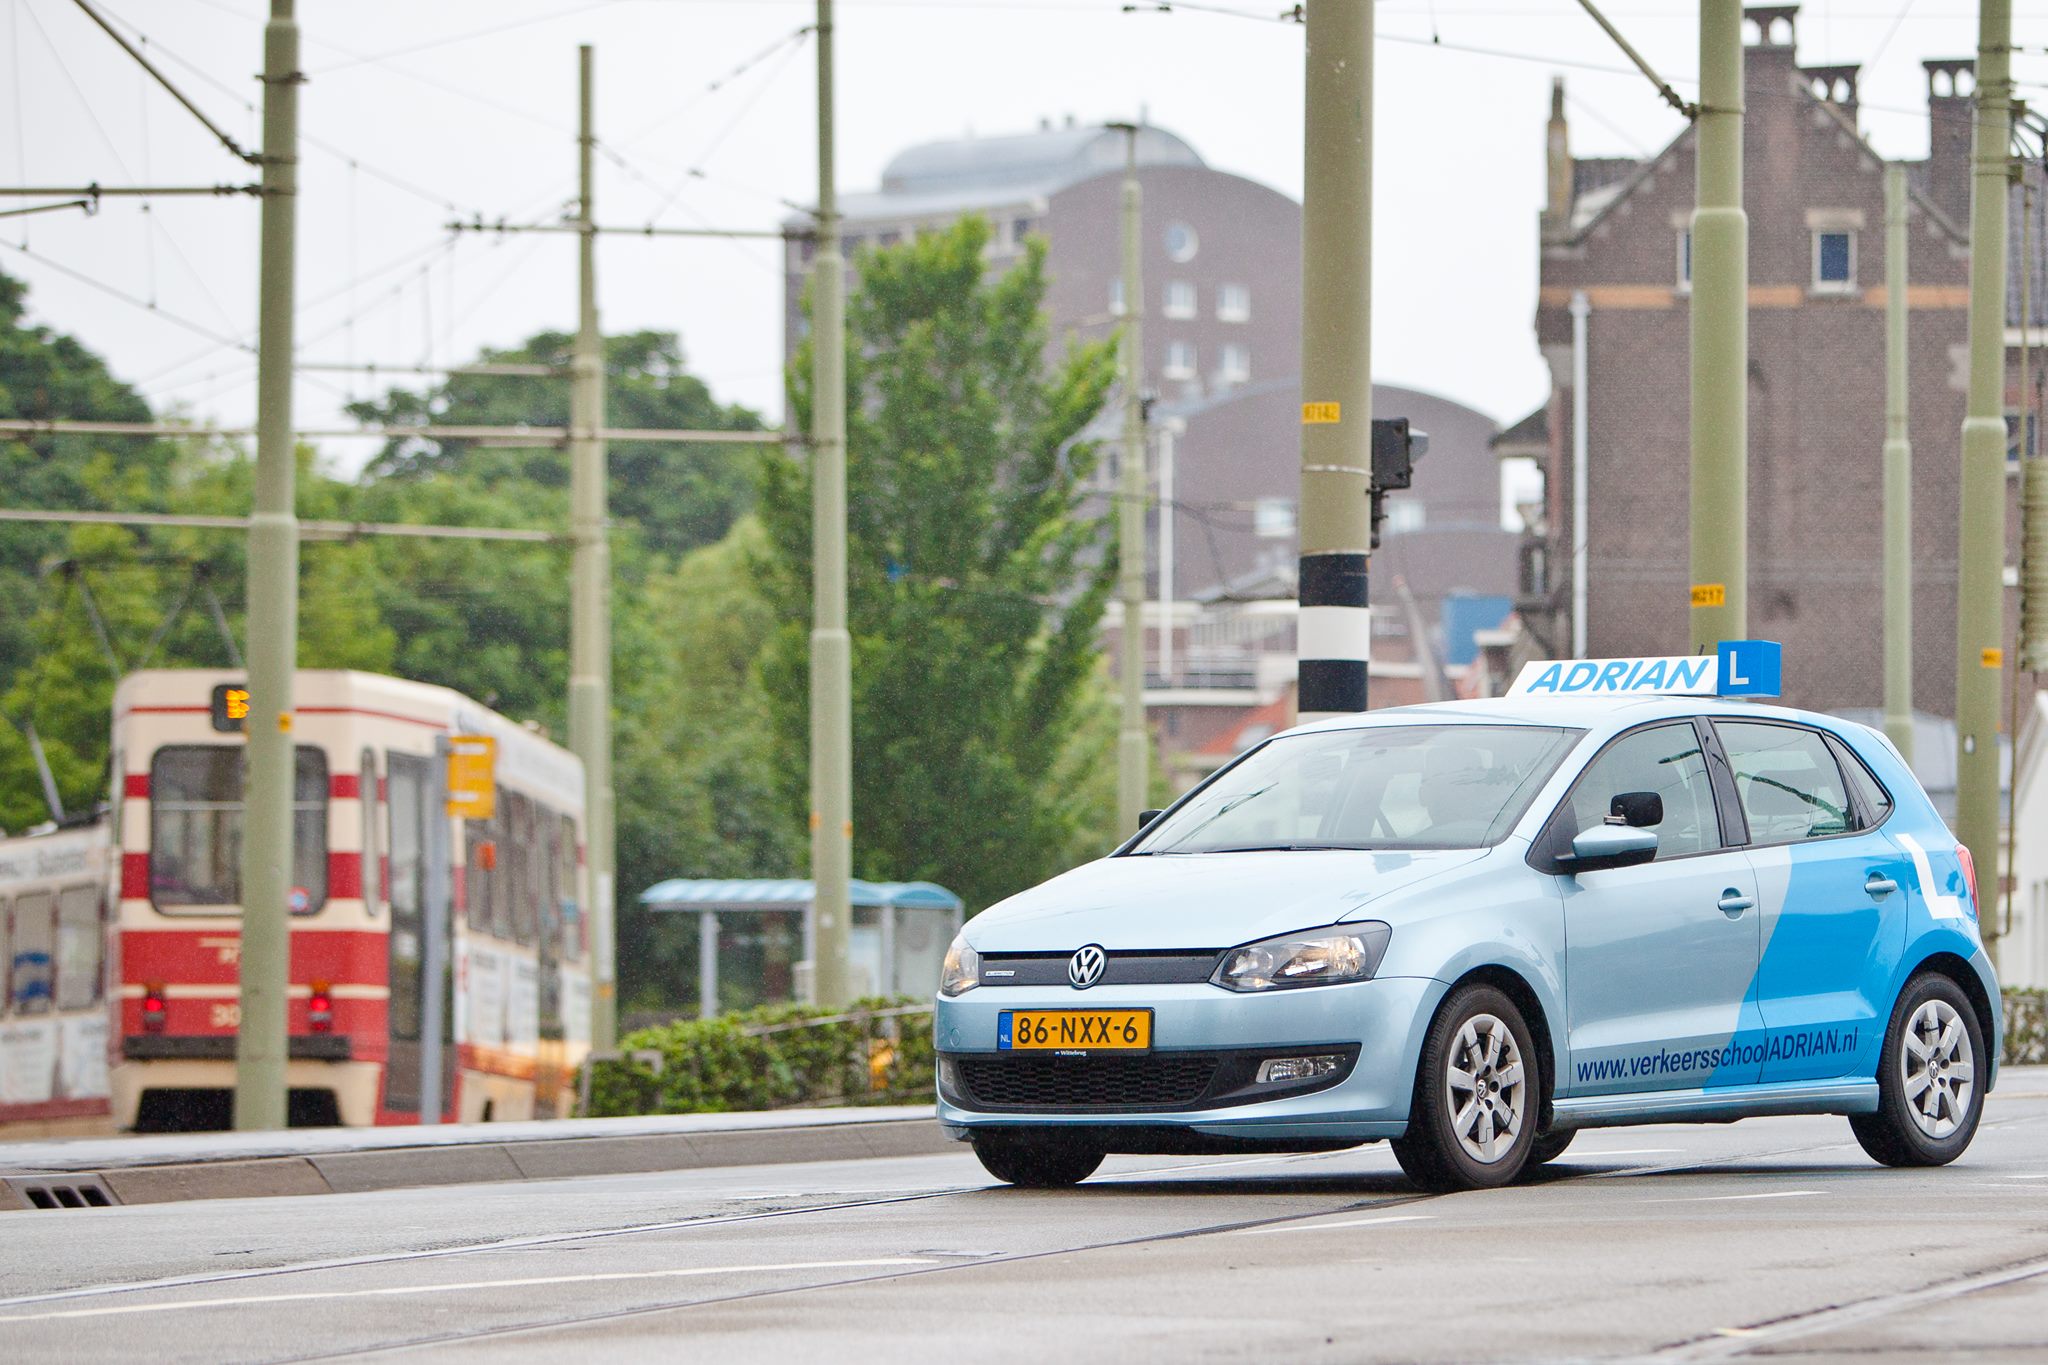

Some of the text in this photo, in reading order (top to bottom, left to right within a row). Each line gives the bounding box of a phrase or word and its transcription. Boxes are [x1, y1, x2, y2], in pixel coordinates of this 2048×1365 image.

[1526, 658, 1710, 693] ADRIAN
[1729, 650, 1750, 686] L
[1069, 946, 1105, 986] VW
[1000, 1016, 1138, 1044] NL 86-NXX-6
[1577, 1026, 1858, 1082] www.verkeersschoolADRIAN.nl
